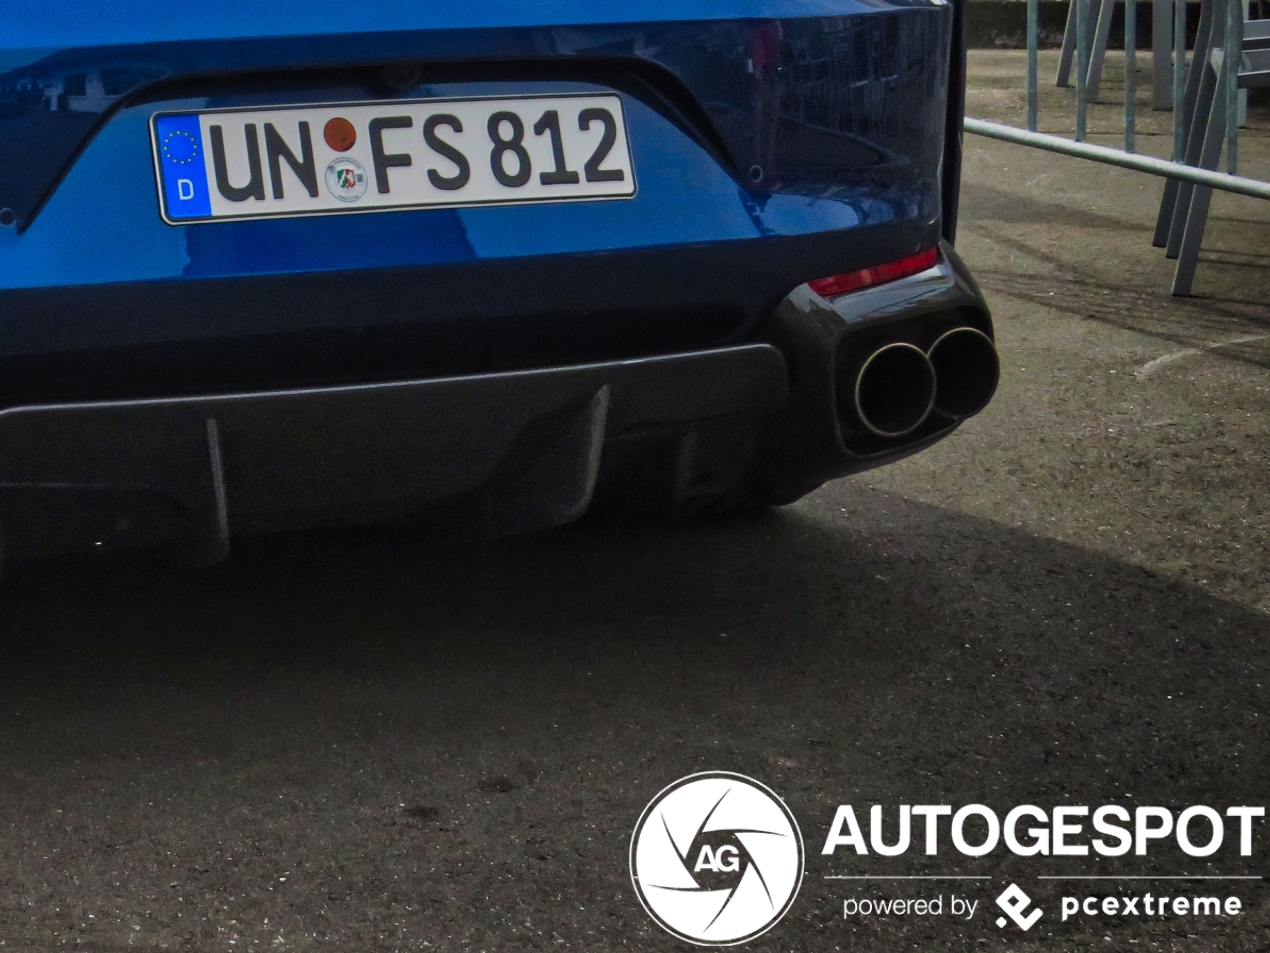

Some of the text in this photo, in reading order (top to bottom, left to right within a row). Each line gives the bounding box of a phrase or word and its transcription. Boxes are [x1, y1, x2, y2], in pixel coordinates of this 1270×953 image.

[209, 107, 626, 203] UN FS 812
[177, 179, 195, 201] D
